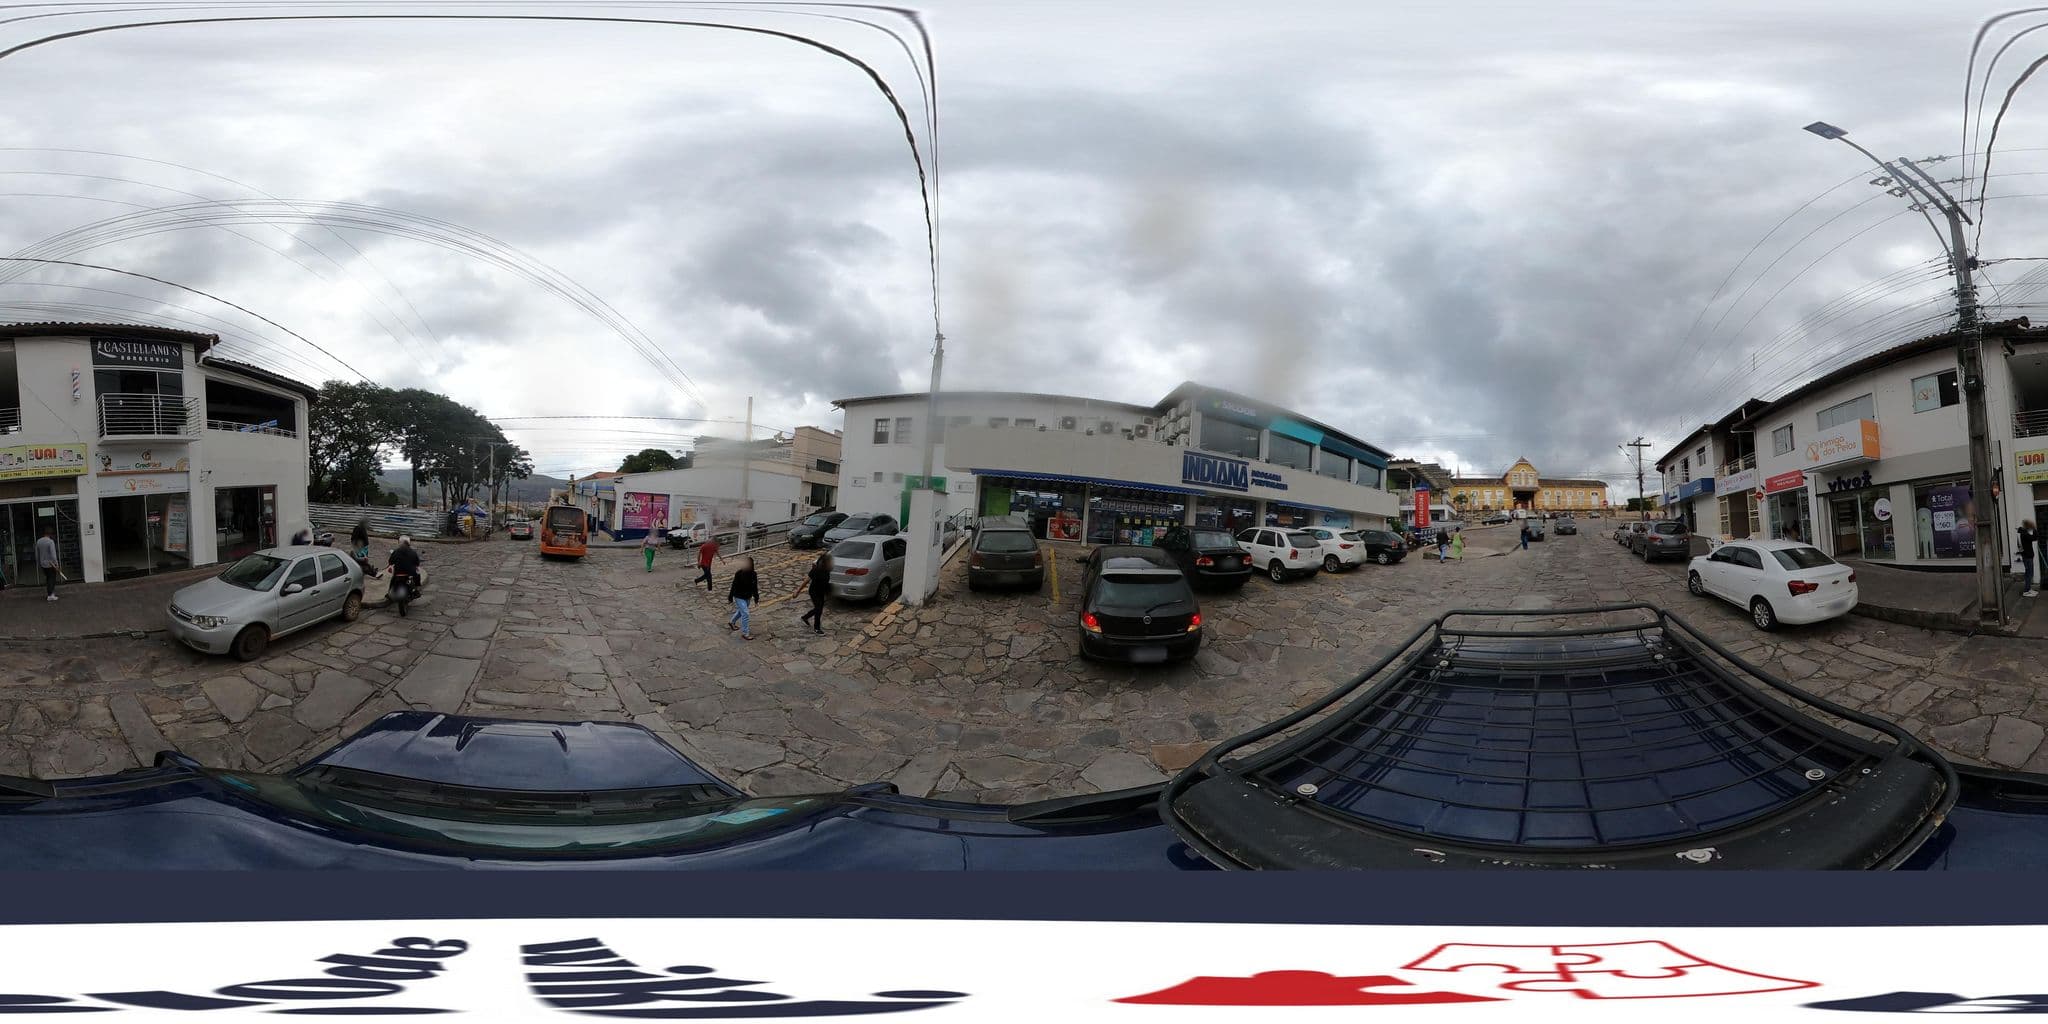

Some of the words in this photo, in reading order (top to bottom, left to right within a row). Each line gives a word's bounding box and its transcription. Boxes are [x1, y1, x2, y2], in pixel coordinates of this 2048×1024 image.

[104, 341, 179, 357] CASTELLANO'S
[1183, 454, 1249, 489] INDIANA
[1828, 477, 1861, 492] vivo
[1937, 494, 1953, 503] Total
